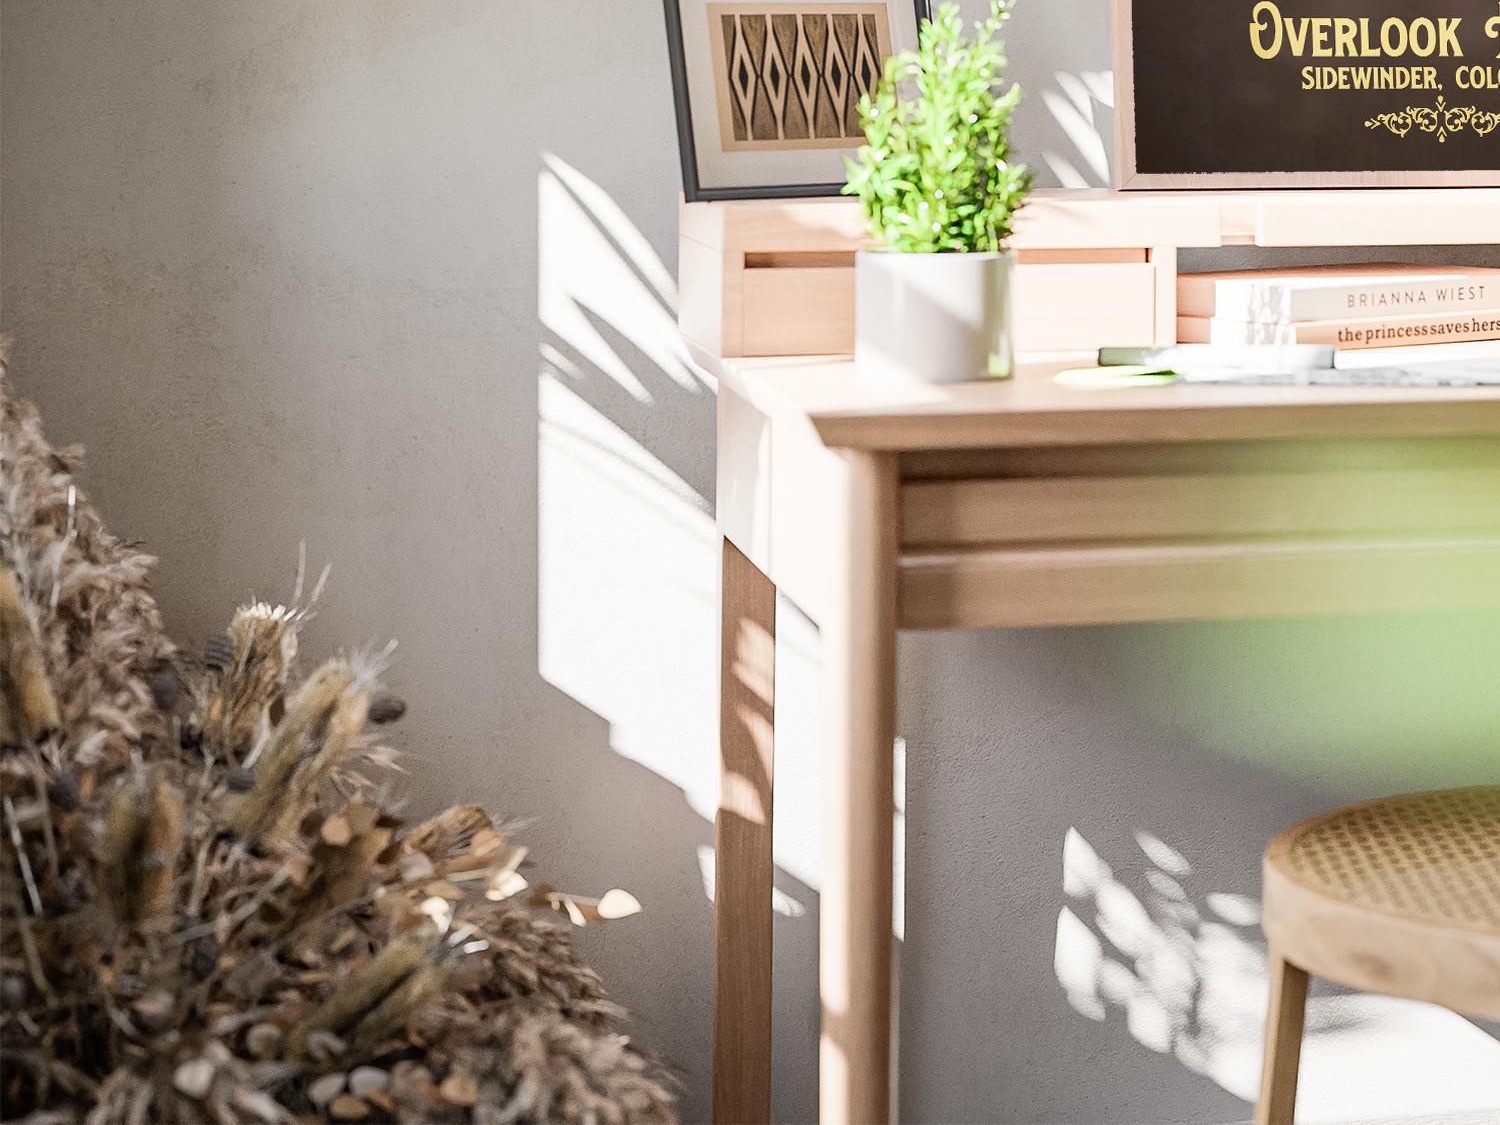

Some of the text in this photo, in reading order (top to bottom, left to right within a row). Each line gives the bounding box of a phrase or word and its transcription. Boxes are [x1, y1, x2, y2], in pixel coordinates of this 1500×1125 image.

[1301, 65, 1443, 90] SIDEWINDER,
[1346, 285, 1486, 308] BRIANNA WIEST
